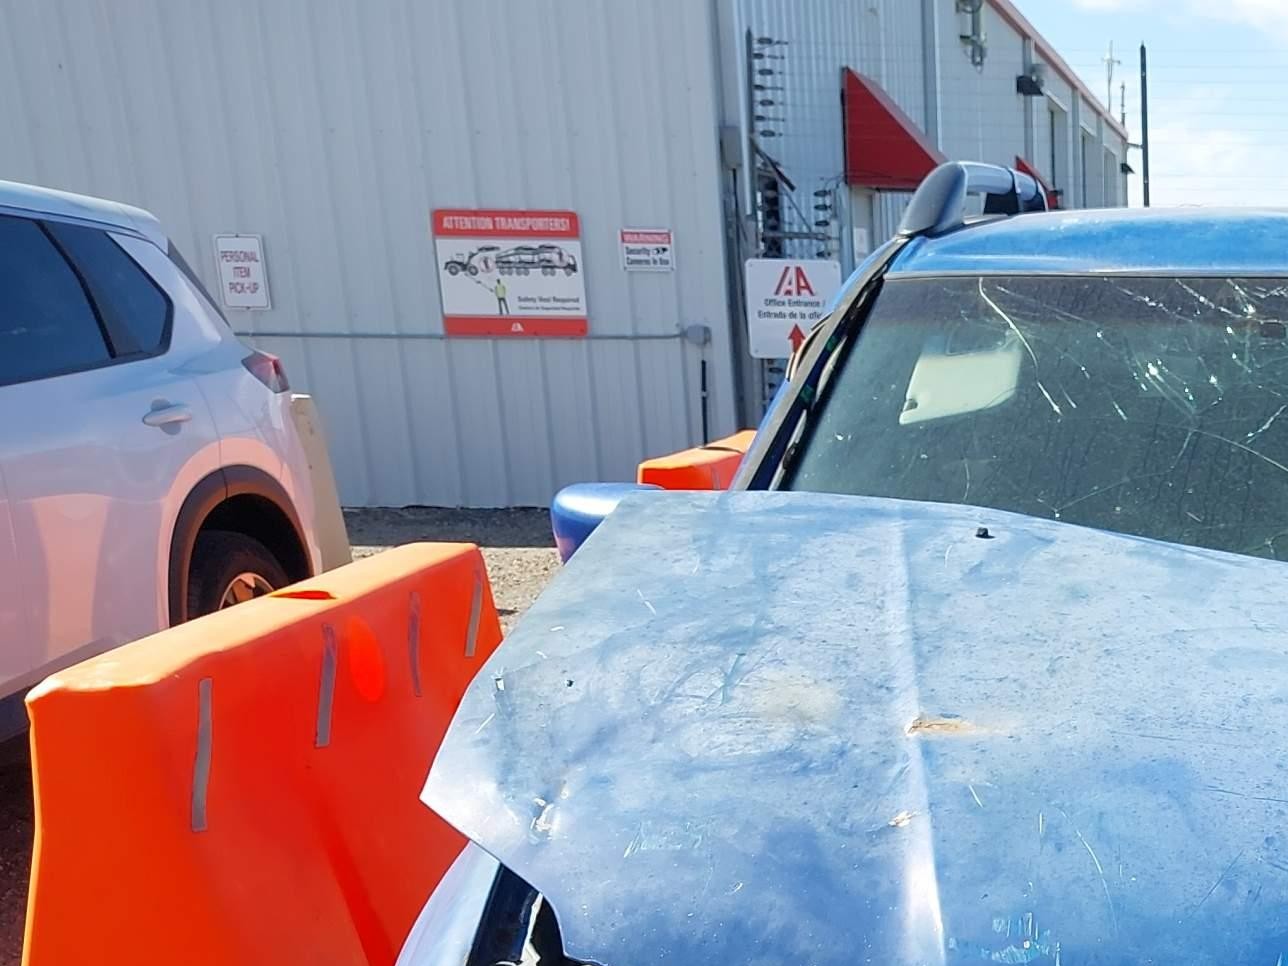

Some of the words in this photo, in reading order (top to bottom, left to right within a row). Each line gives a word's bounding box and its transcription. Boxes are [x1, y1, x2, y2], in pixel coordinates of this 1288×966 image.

[443, 216, 494, 230] ATTENTION
[495, 217, 570, 231] TRANSPORTERS!
[220, 250, 259, 263] PERSONAL
[625, 246, 650, 256] Security
[233, 266, 251, 278] ITEM
[228, 282, 259, 294] PICK-UP
[764, 299, 785, 307] Office
[788, 299, 820, 307] Entrance
[758, 311, 786, 319] Entrada
[788, 311, 798, 319] de
